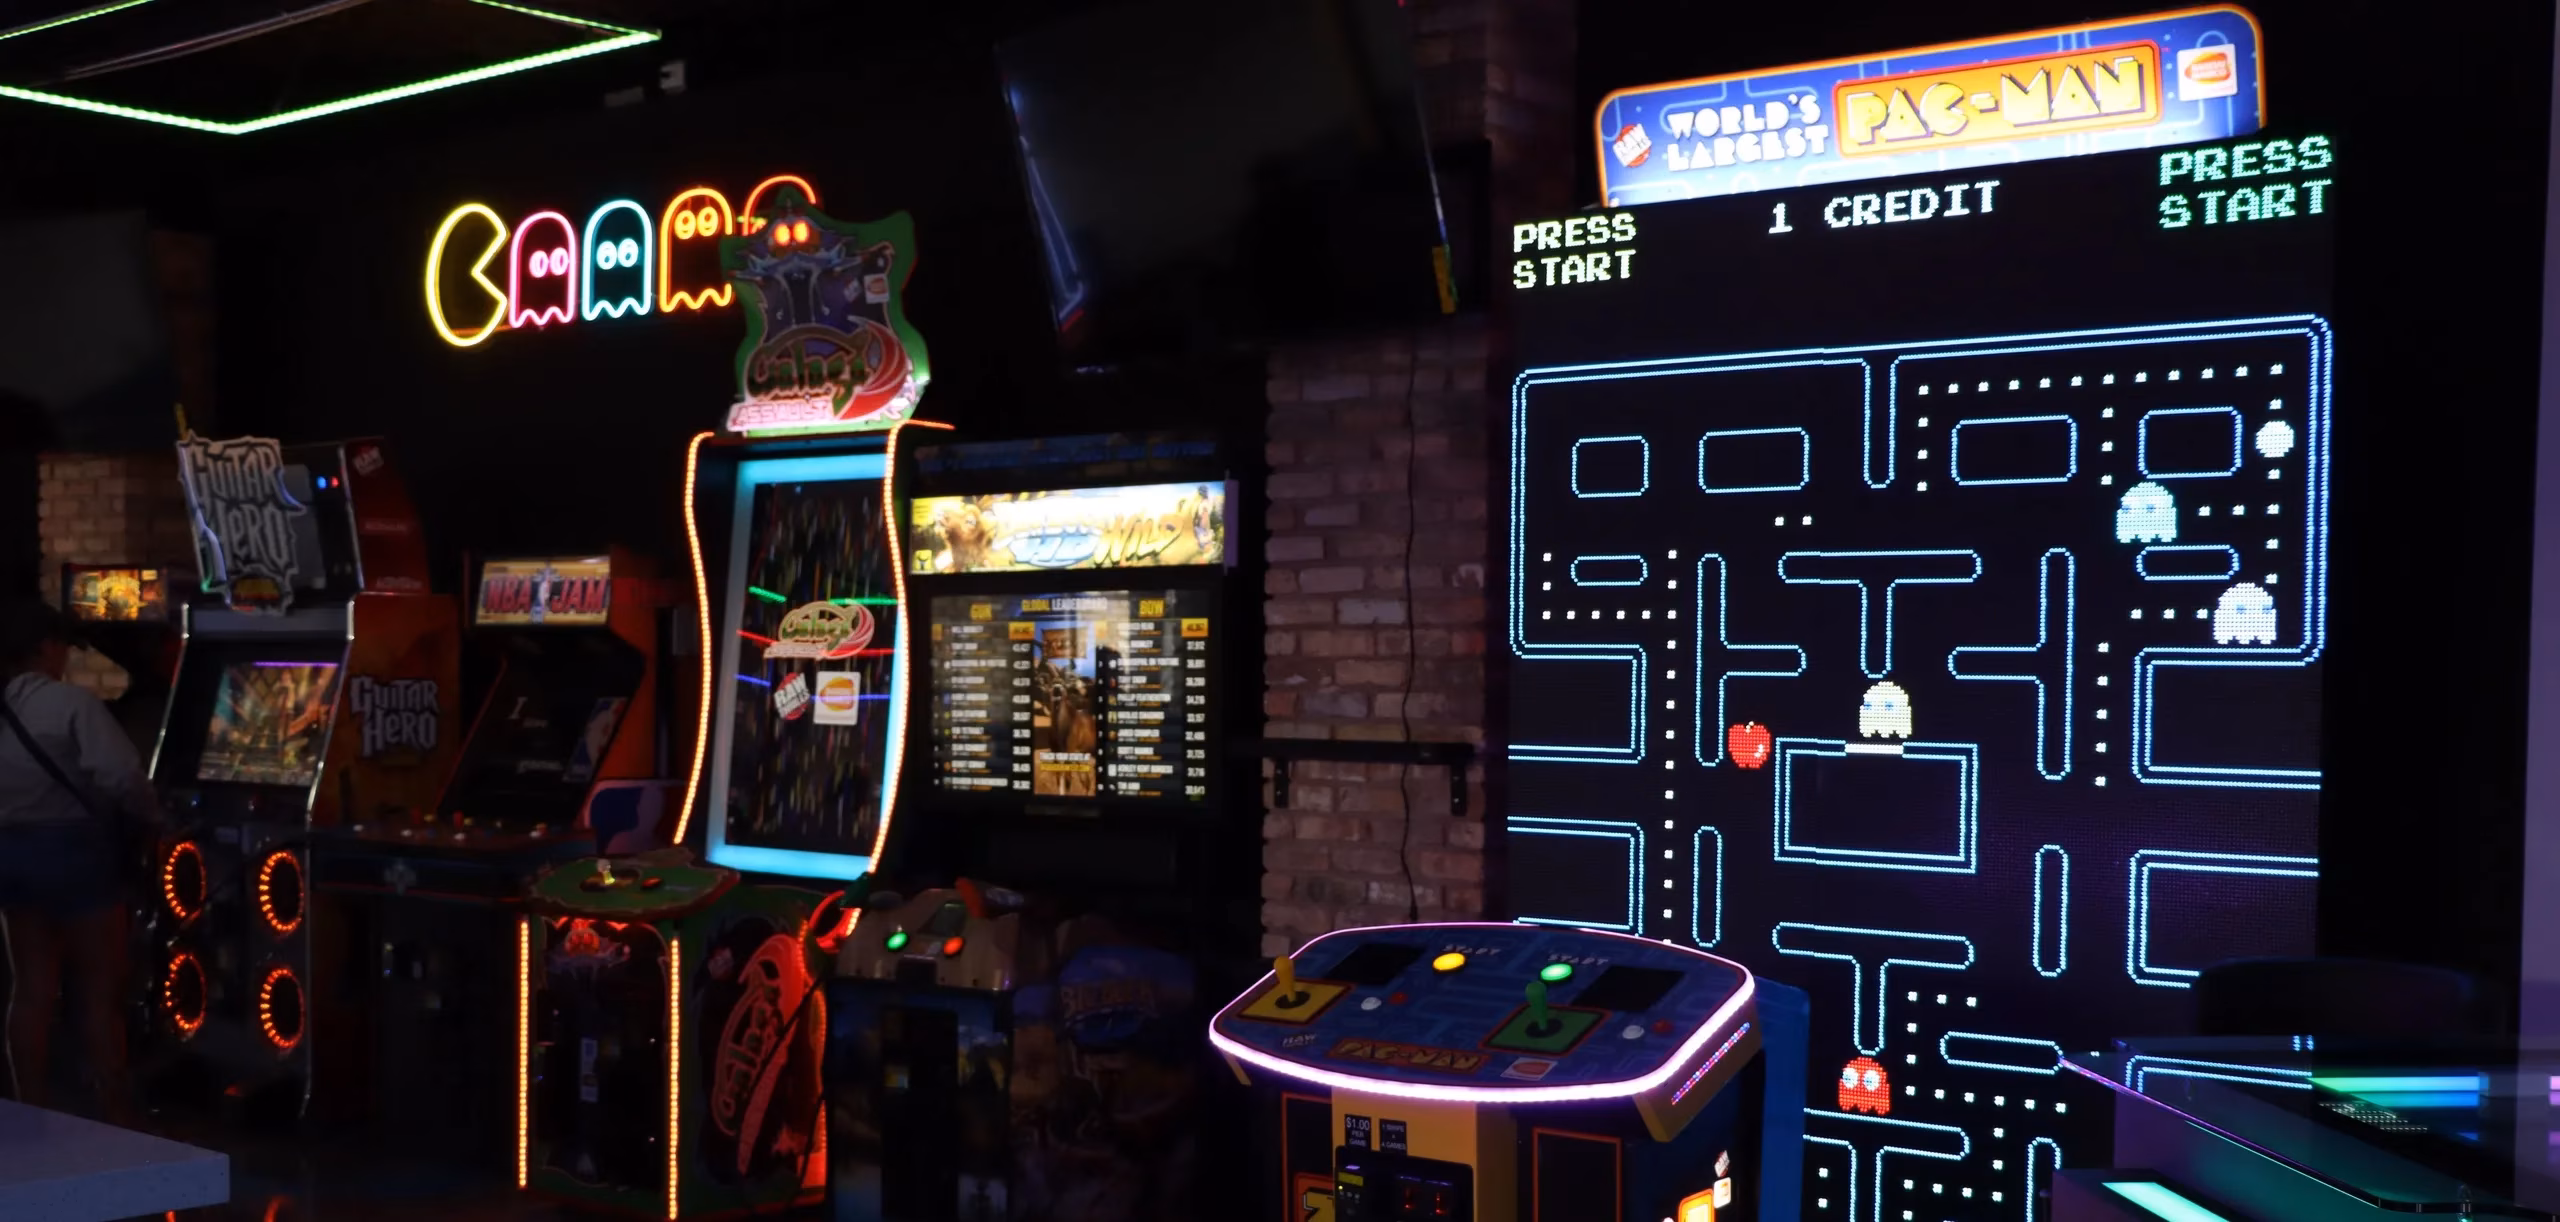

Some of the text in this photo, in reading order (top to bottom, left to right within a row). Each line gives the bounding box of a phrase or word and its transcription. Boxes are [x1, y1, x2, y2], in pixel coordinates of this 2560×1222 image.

[1667, 95, 1822, 139] WORLD'S
[1848, 57, 2146, 146] PAC-MAN
[1668, 127, 1829, 172] LARGEST
[2159, 136, 2333, 186] PRESS
[1769, 181, 2000, 234] 1 CREDIT
[2159, 180, 2333, 229] START
[1513, 212, 1637, 252] PRESS
[1513, 249, 1638, 289] START
[485, 575, 609, 614] NBA JAM
[349, 675, 441, 722] GUITAR
[361, 708, 438, 758] HERO
[1442, 943, 1502, 956] START
[1547, 953, 1609, 966] START
[1339, 1042, 1481, 1070] PAC-MAN
[1346, 1116, 1370, 1130] $1.00
